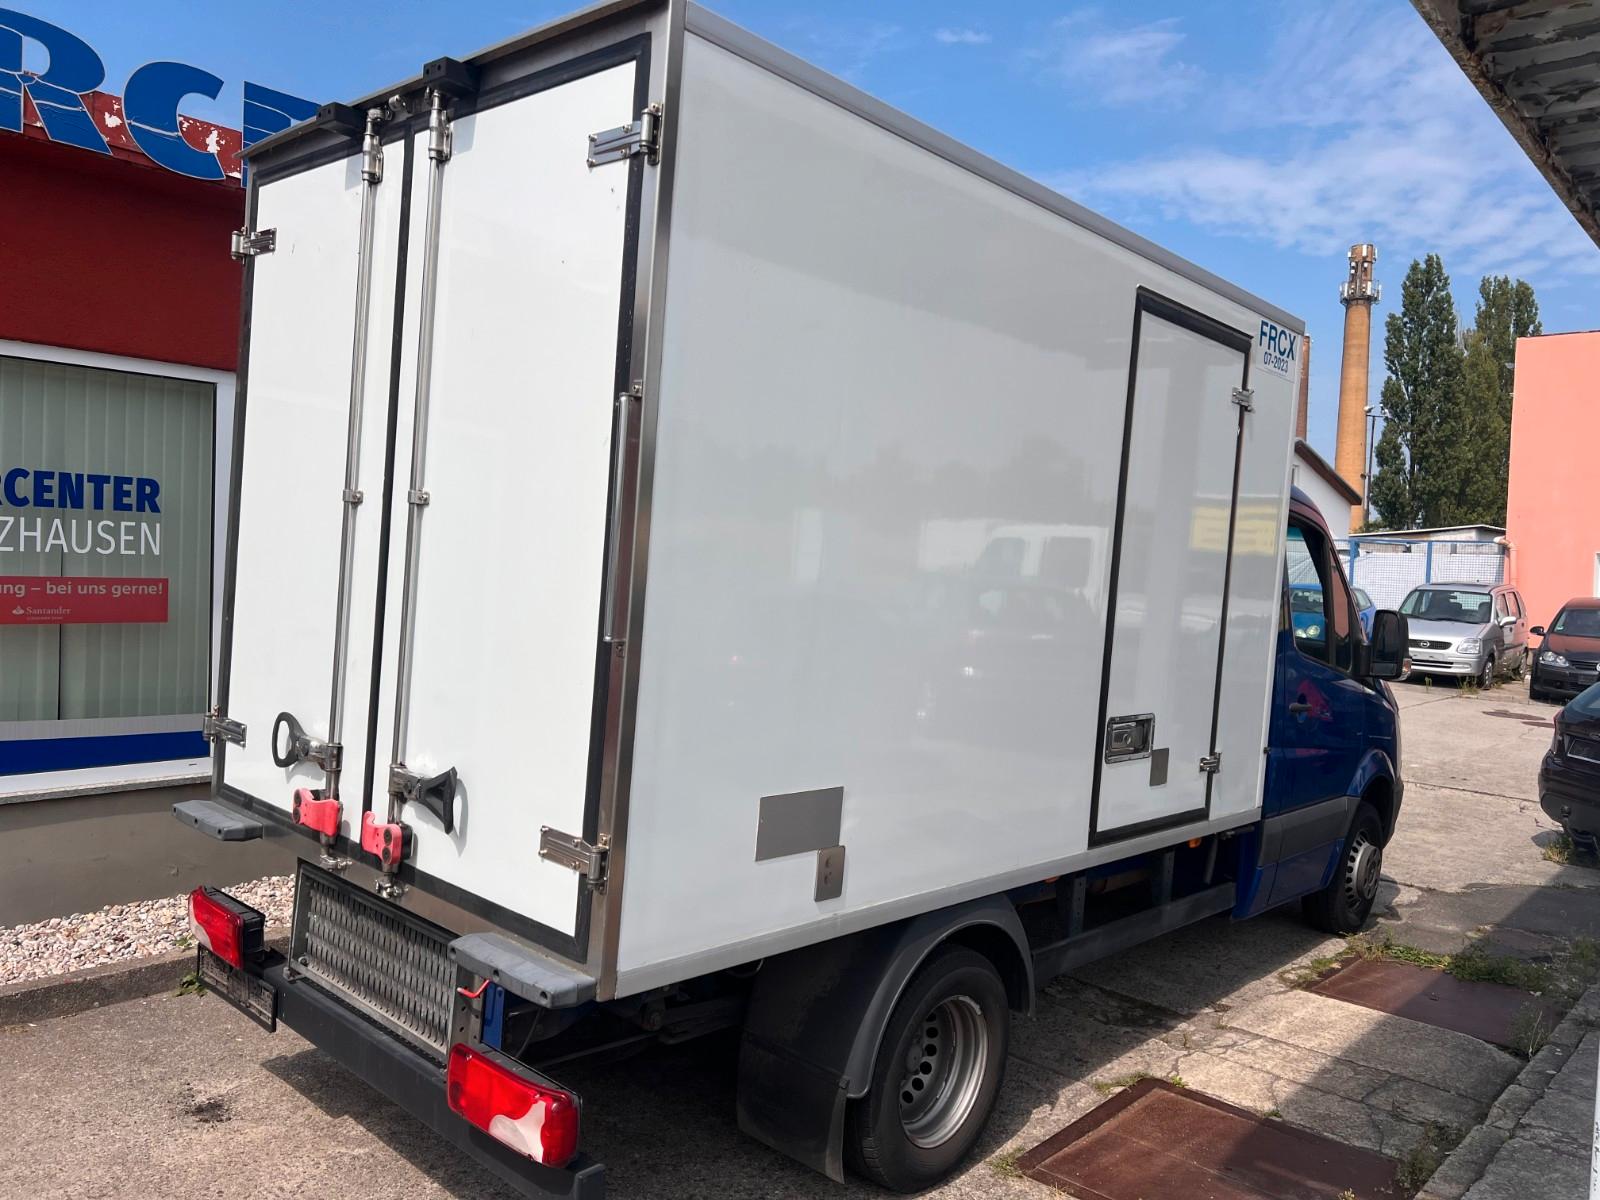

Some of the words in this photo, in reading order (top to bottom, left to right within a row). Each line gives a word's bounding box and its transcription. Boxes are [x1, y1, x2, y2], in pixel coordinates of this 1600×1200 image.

[1259, 320, 1296, 361] FRCX
[1263, 351, 1289, 373] 07-2023
[0, 468, 161, 513] CENTER
[0, 516, 161, 555] ZHAUSEN
[0, 584, 25, 597] ng
[46, 581, 72, 594] bei
[77, 584, 106, 595] uns
[111, 583, 163, 597] gerne!
[26, 606, 71, 615] Santander
